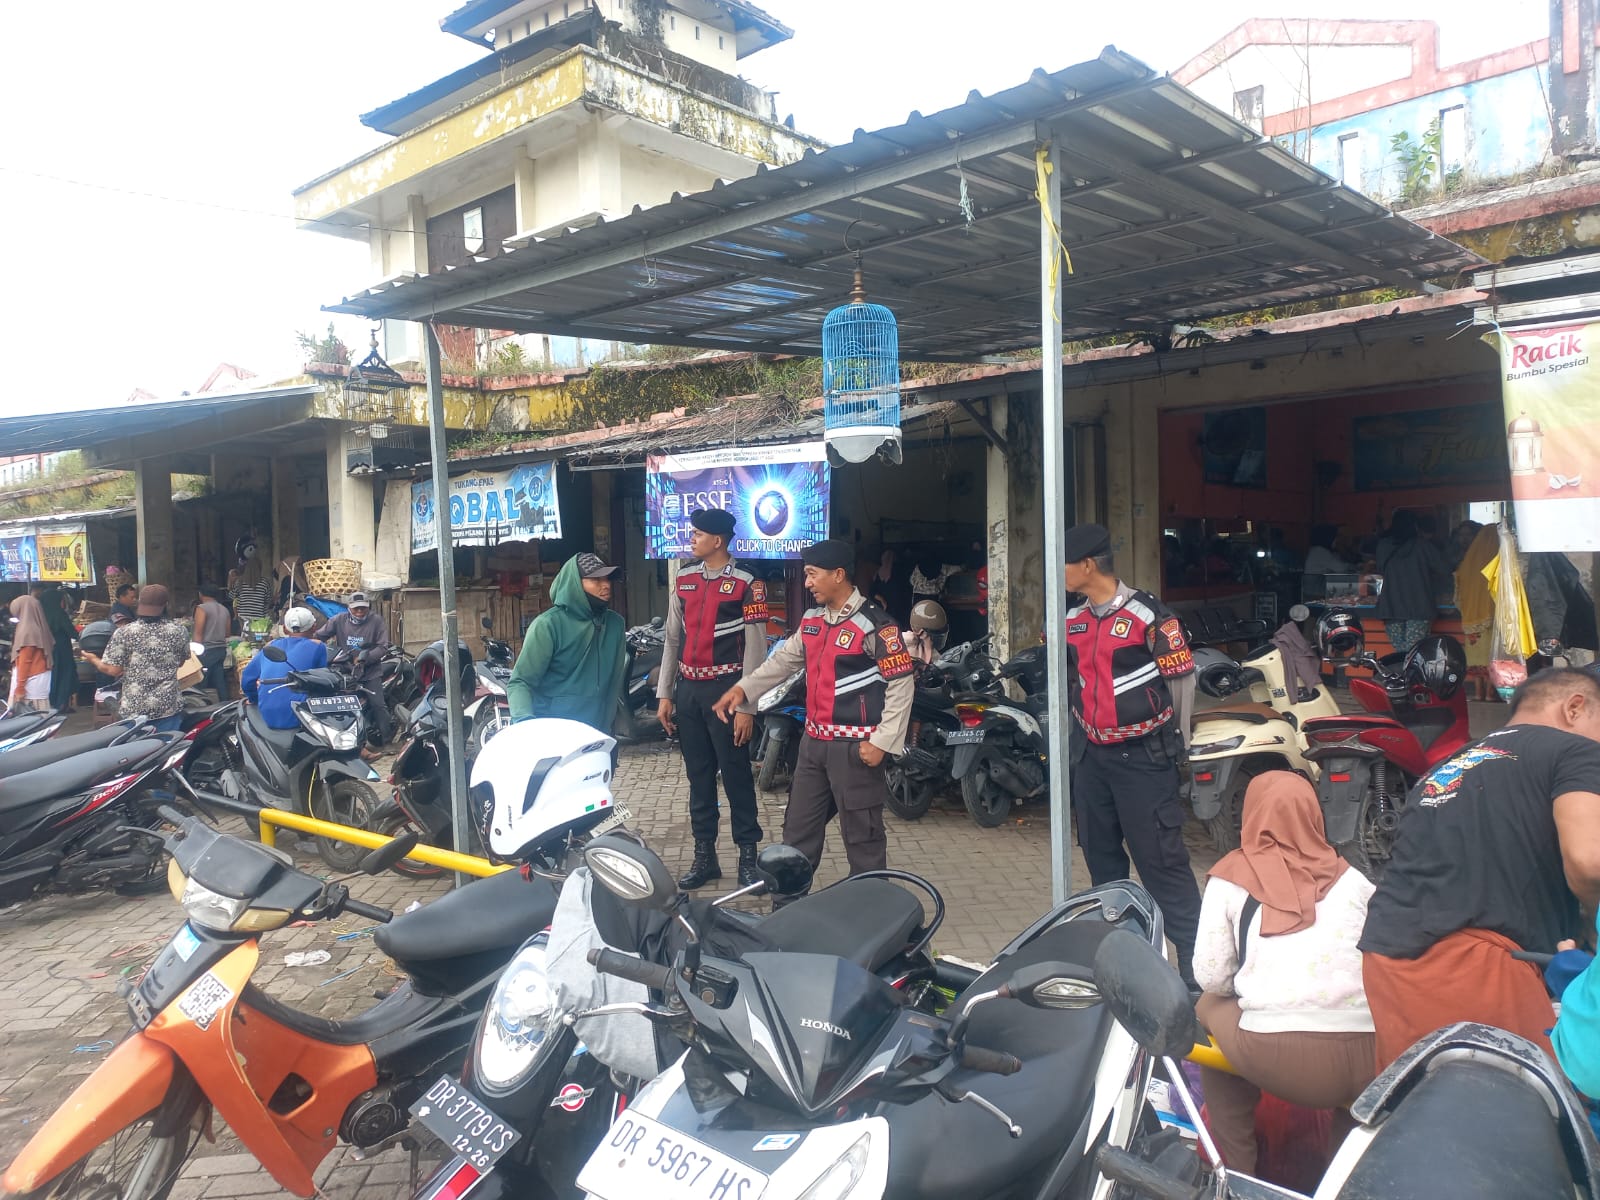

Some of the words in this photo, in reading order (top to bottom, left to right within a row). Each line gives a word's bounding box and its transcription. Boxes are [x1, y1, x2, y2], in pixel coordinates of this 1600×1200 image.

[1511, 334, 1583, 369] Racik
[1506, 367, 1546, 382] Bumbu
[1548, 356, 1589, 373] Spesial
[454, 478, 479, 489] TUKANG
[682, 490, 733, 517] ESSE
[736, 539, 760, 552] CLICK
[761, 539, 773, 552] TO
[775, 539, 813, 553] CHANGE
[800, 1017, 852, 1041] HONDA
[426, 1078, 457, 1109] DR
[446, 1095, 493, 1137] 3779
[482, 1124, 514, 1153] CS
[610, 1119, 647, 1156] DR
[647, 1136, 713, 1188] 5967
[709, 1167, 751, 1200] HS
